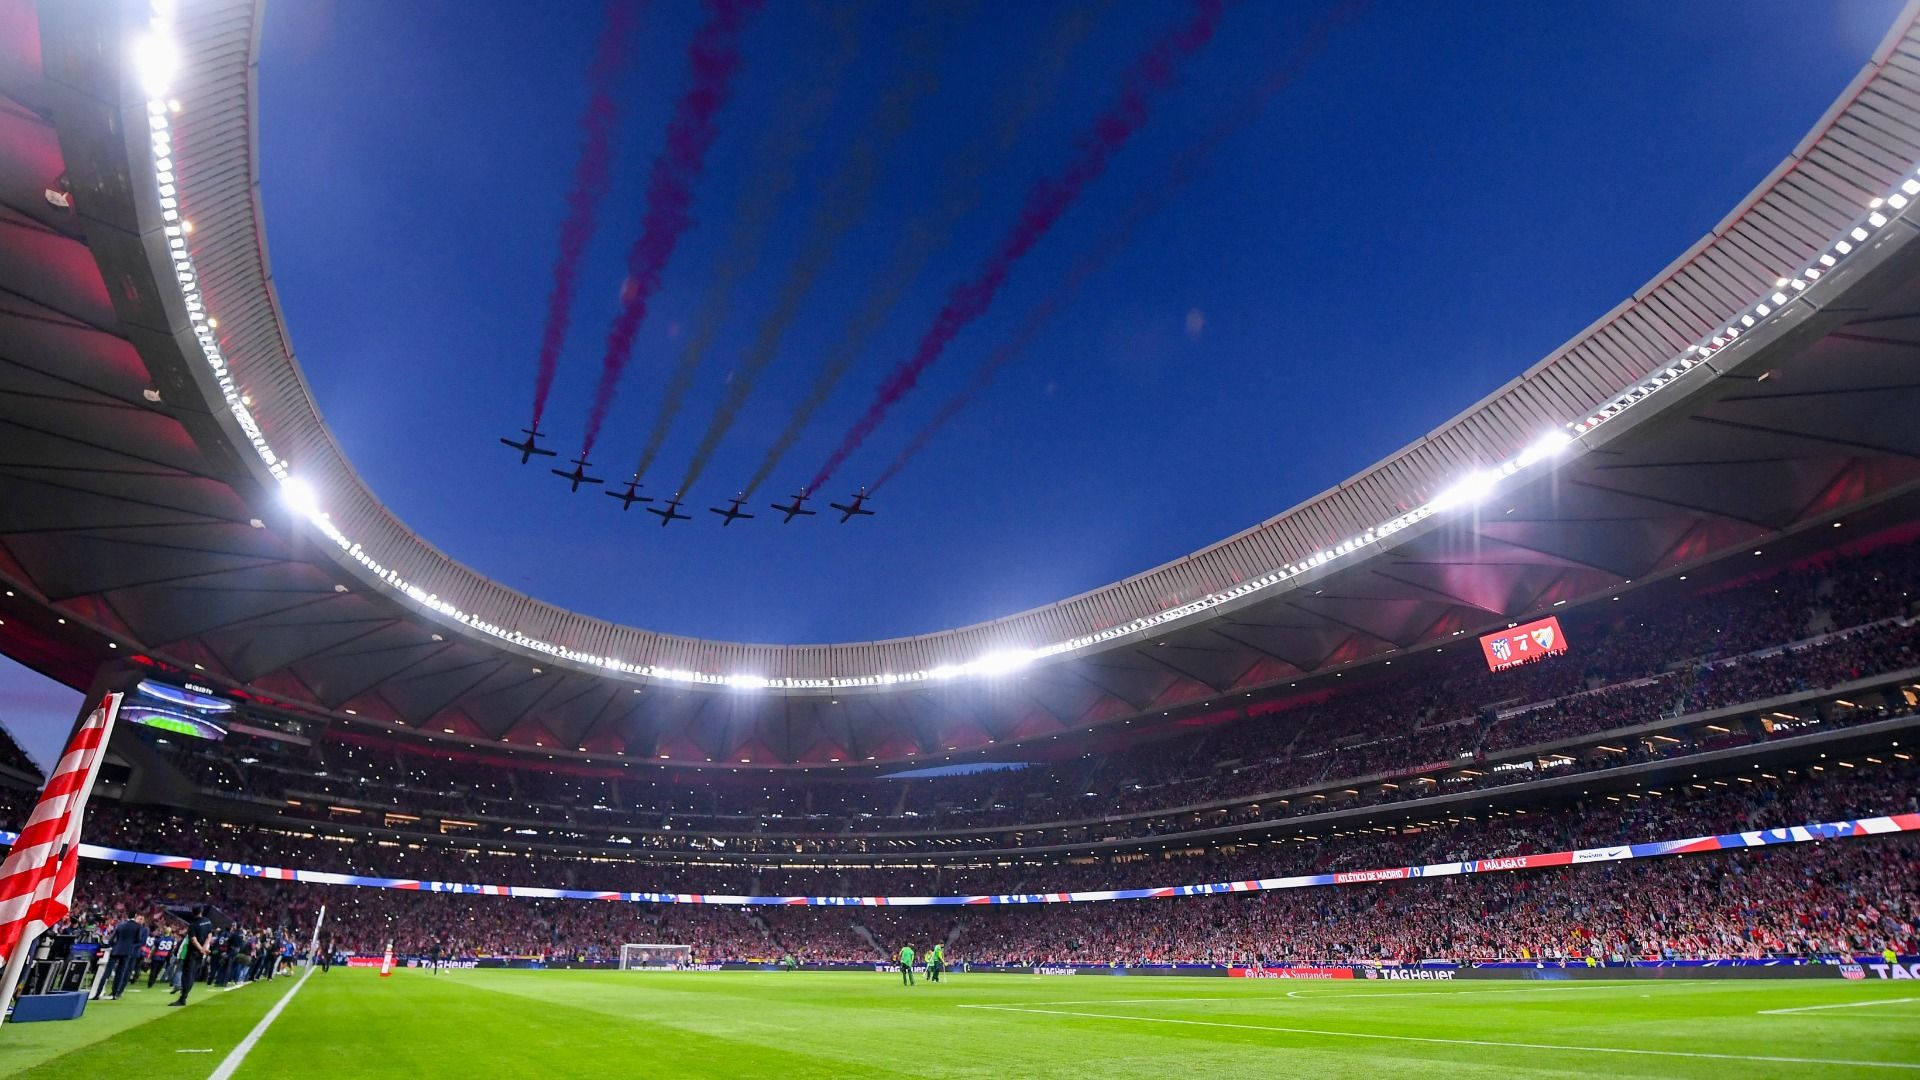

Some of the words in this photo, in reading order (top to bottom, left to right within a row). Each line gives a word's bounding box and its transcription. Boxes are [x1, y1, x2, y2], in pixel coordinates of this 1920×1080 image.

[1464, 862, 1473, 872] 0
[1483, 859, 1518, 871] MÁLAGA
[1518, 858, 1527, 868] CF
[1338, 873, 1367, 883] ATLÉTICO
[1368, 872, 1376, 881] DE
[1376, 870, 1403, 880] MADRID
[1413, 867, 1421, 876] 0
[158, 940, 173, 951] 58
[1290, 968, 1333, 979] Santander
